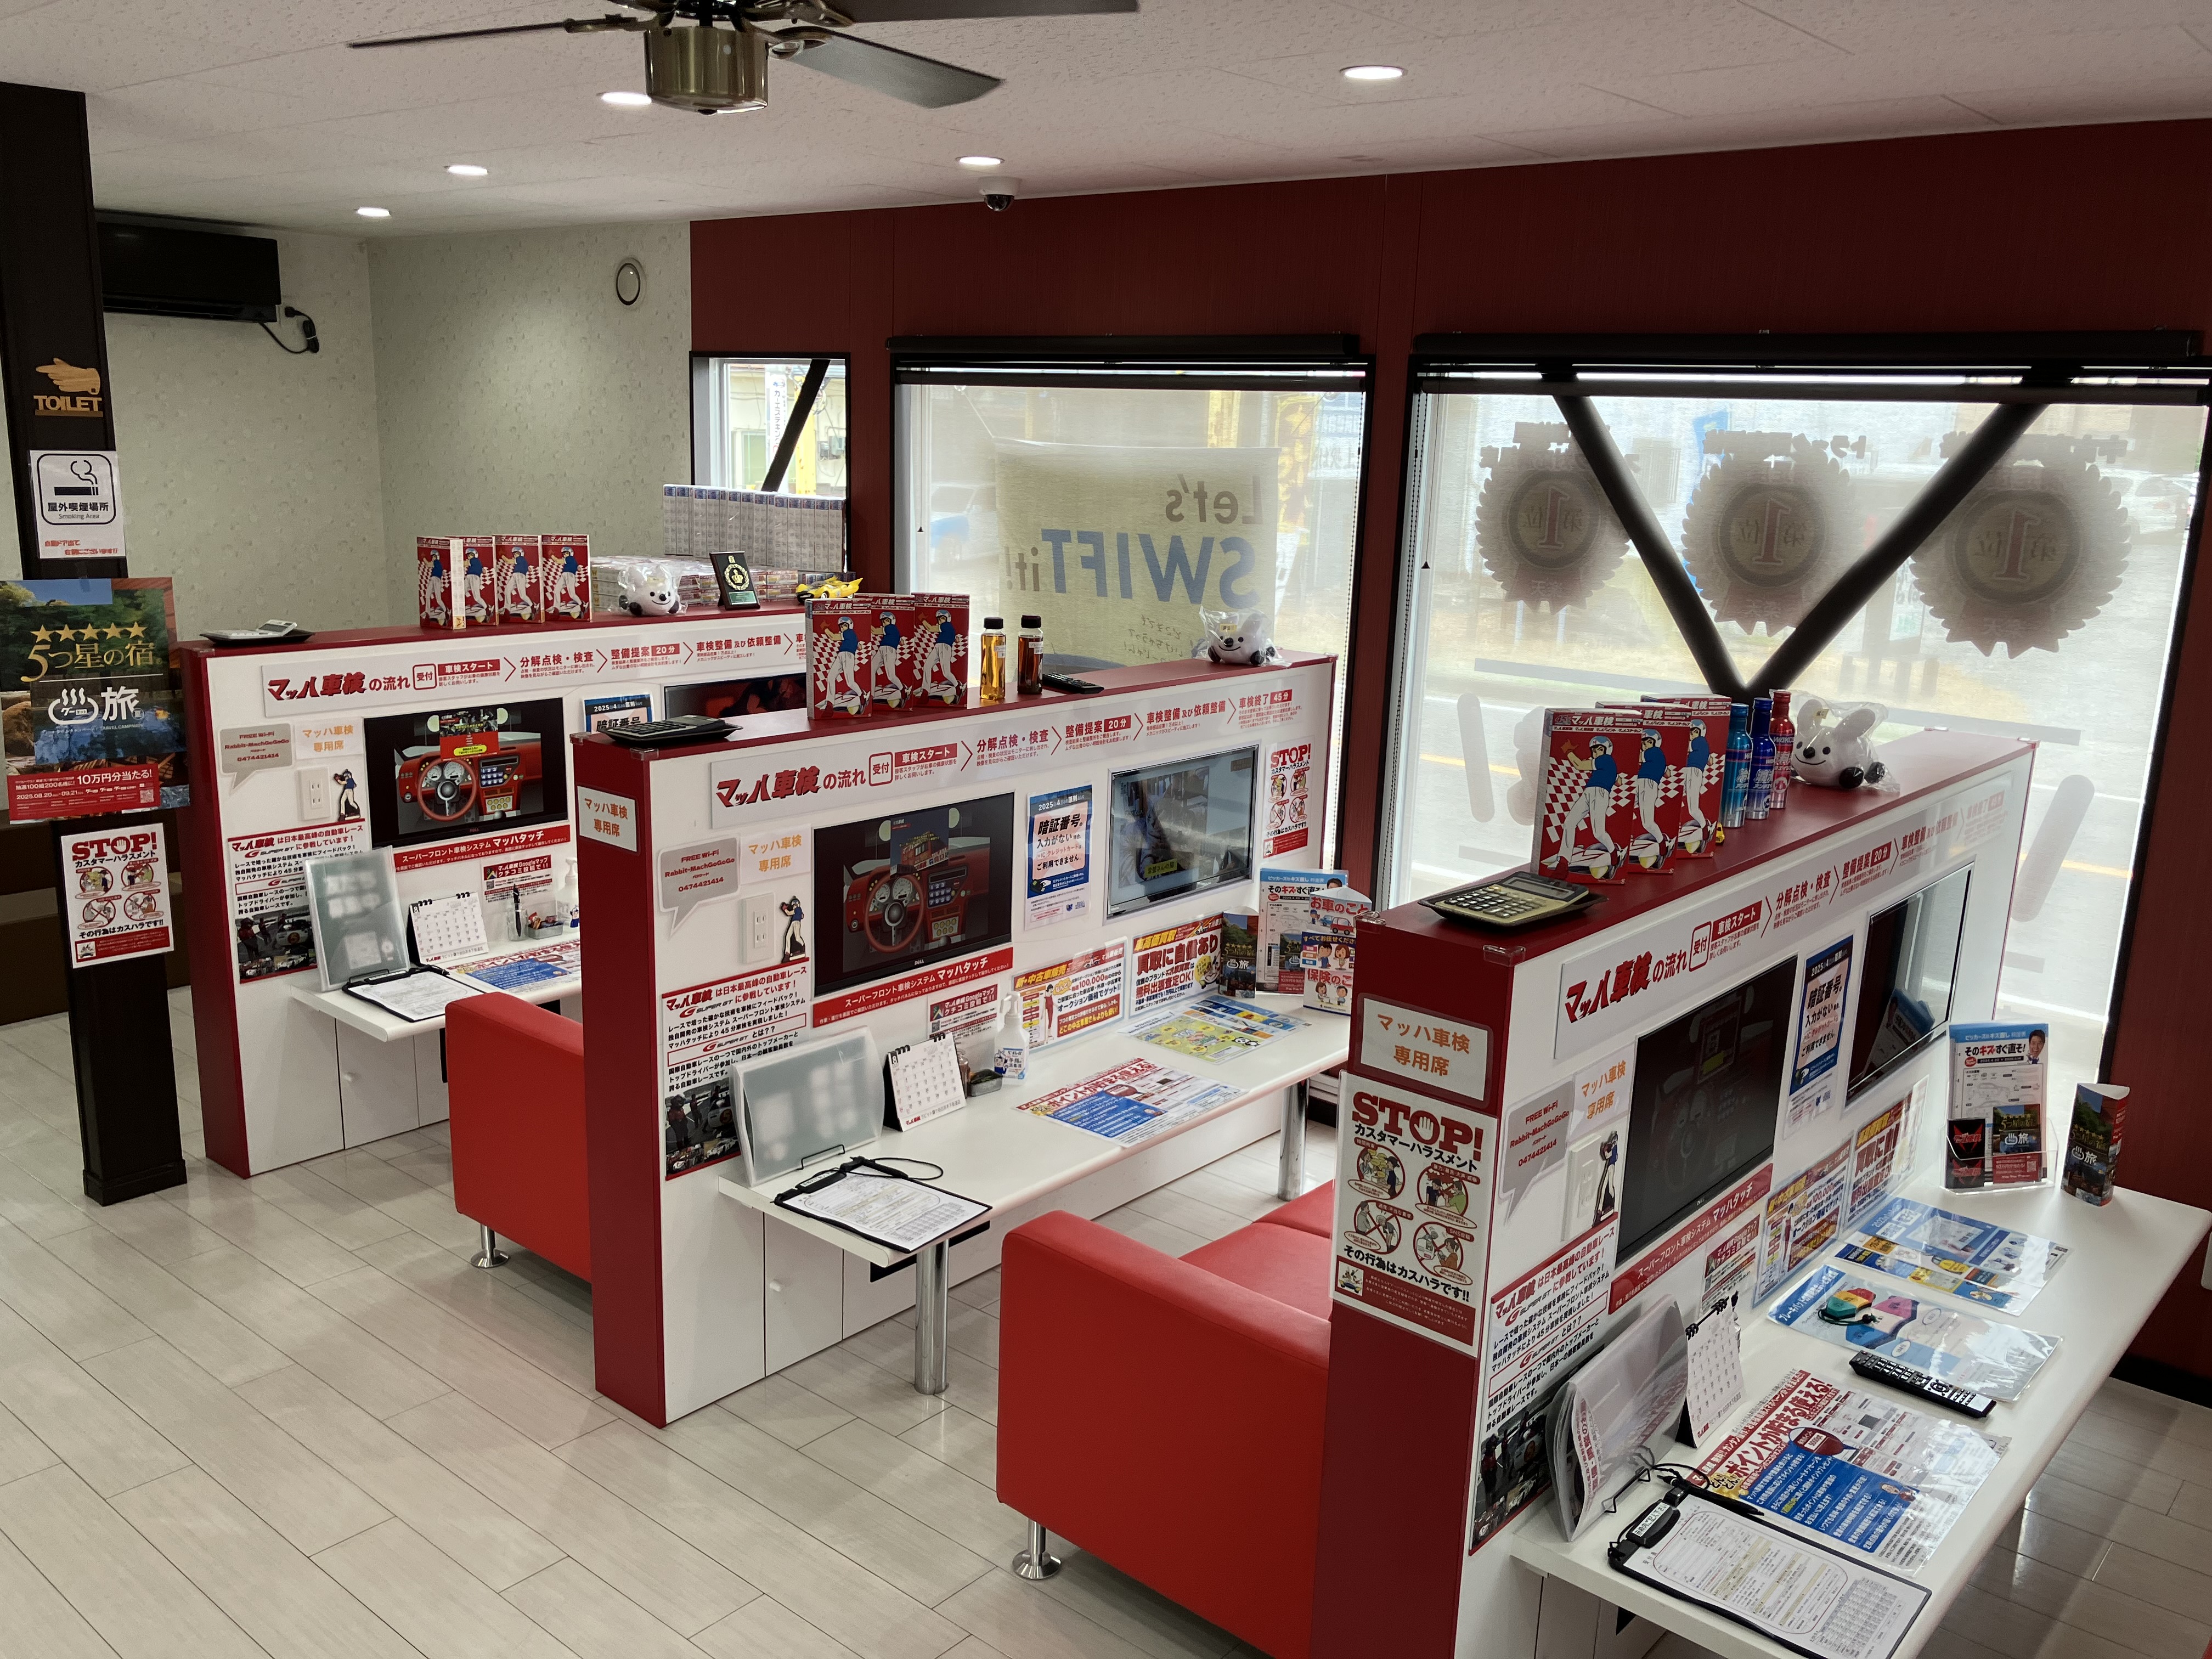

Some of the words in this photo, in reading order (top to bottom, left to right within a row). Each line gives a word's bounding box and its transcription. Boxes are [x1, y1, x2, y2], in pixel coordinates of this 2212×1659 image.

[33, 395, 102, 413] TOILET
[48, 503, 109, 511] 屋外喫煙場所
[20, 640, 155, 681] 5つ星の宿
[520, 651, 593, 668] 分解点検・検査
[611, 646, 651, 659] 整備提案
[656, 646, 675, 654] 20分
[416, 672, 433, 681] 受付
[445, 663, 493, 673] 車検スタート
[267, 672, 366, 701] マッハ車検
[369, 675, 410, 691] の流れ
[101, 686, 139, 721] 旅
[1239, 693, 1269, 708] 車検終了
[1273, 691, 1289, 702] 45分
[302, 725, 353, 738] マッハ車検
[1065, 720, 1103, 738] 整備提案
[1108, 718, 1127, 730] 20分
[1571, 715, 1614, 726] マッハ車検
[314, 740, 344, 752] 専用席
[977, 729, 1048, 753] 分解点検・検査
[238, 753, 279, 761] 0474421414
[902, 746, 950, 763] 車検スタート
[1271, 743, 1311, 769] STOP!
[77, 769, 152, 785] 10万円分当たる!
[872, 761, 890, 775] 受付
[895, 759, 957, 774] 接客スタッフがお車の健康状態を
[895, 770, 935, 781] 詳しくお伺いします。
[1271, 759, 1310, 775] カスタマーハラスメント
[715, 765, 822, 808] マッハ車検
[823, 768, 866, 790] の流れ
[584, 798, 628, 820] マッハ車検
[232, 837, 275, 852] マッハ車検
[278, 825, 363, 844] は日本最高峰の自動車レース
[594, 819, 620, 837] 専用席
[72, 832, 157, 861] STOP!
[402, 842, 491, 862] スーパーフロント車検システム
[493, 831, 544, 847] マッハタッチ
[749, 834, 802, 854] マッハ車検
[75, 851, 155, 868] カスタマーハラスメント
[681, 854, 701, 863] FREE
[702, 849, 719, 858] Wi-Fi
[759, 855, 792, 872] 専用席
[1842, 850, 1871, 880] 整備提案
[1874, 847, 1888, 863] 20分
[665, 857, 735, 878] Rabbit-MachGoGoGo
[678, 877, 724, 892] 0474421414
[1776, 869, 1832, 911] 分解点検・検査
[1311, 896, 1368, 918] お車のこと
[1717, 910, 1756, 935] 車検スタート
[1303, 935, 1356, 945] すべてお任せくださ
[1693, 935, 1707, 956] 受付
[1137, 934, 1218, 975] 買取に自信あり
[1239, 960, 1249, 969] 旅
[845, 976, 935, 1007] スーパーフロント車検システム
[938, 957, 988, 980] マッハタッチ
[1015, 964, 1068, 986] 新・中古車販売
[1307, 968, 1352, 987] 保険のこ
[1565, 951, 1653, 1023] マッハ車検
[1653, 949, 1687, 983] の流れ
[666, 989, 713, 1011] マッハ車検
[715, 966, 806, 997] は日本最高峰の自動車レース
[696, 1002, 721, 1014] SUPER
[735, 980, 796, 1003] に参戦しています!
[668, 1018, 730, 1041] 独自開発の車検システム
[732, 997, 805, 1023] スーパーフロント車検システム
[669, 992, 797, 1032] レースで培った確かな技術を車検にフィードバック!
[1378, 1014, 1470, 1054] マッハ車検
[669, 1031, 798, 1075] 国際自動車レースの一つで国内外のトップメーカーと
[892, 1056, 896, 1064] 8
[1393, 1045, 1449, 1076] 専用席
[669, 1070, 729, 1092] 誇る自動車レースです。
[1581, 1060, 1626, 1097] マッハ車検
[1526, 1109, 1543, 1125] FREE
[1543, 1100, 1558, 1115] Wi-Fi
[1587, 1091, 1615, 1119] 専用席
[1352, 1091, 1484, 1162] STOP!
[1510, 1110, 1569, 1149] Rabbit-MachGoGoGo
[1355, 1123, 1477, 1172] カスタマーハラスメント
[1519, 1138, 1557, 1167] 0474421414
[2084, 1152, 2098, 1165] 旅
[1638, 1217, 1712, 1279] スーパーフロント車検システム
[1713, 1182, 1753, 1223] マッハタッチ
[1344, 1245, 1469, 1302] その行為はカスハラです!!
[1496, 1279, 1537, 1319] マッハ車検
[1538, 1226, 1615, 1289] は日本最高峰の自動車レース
